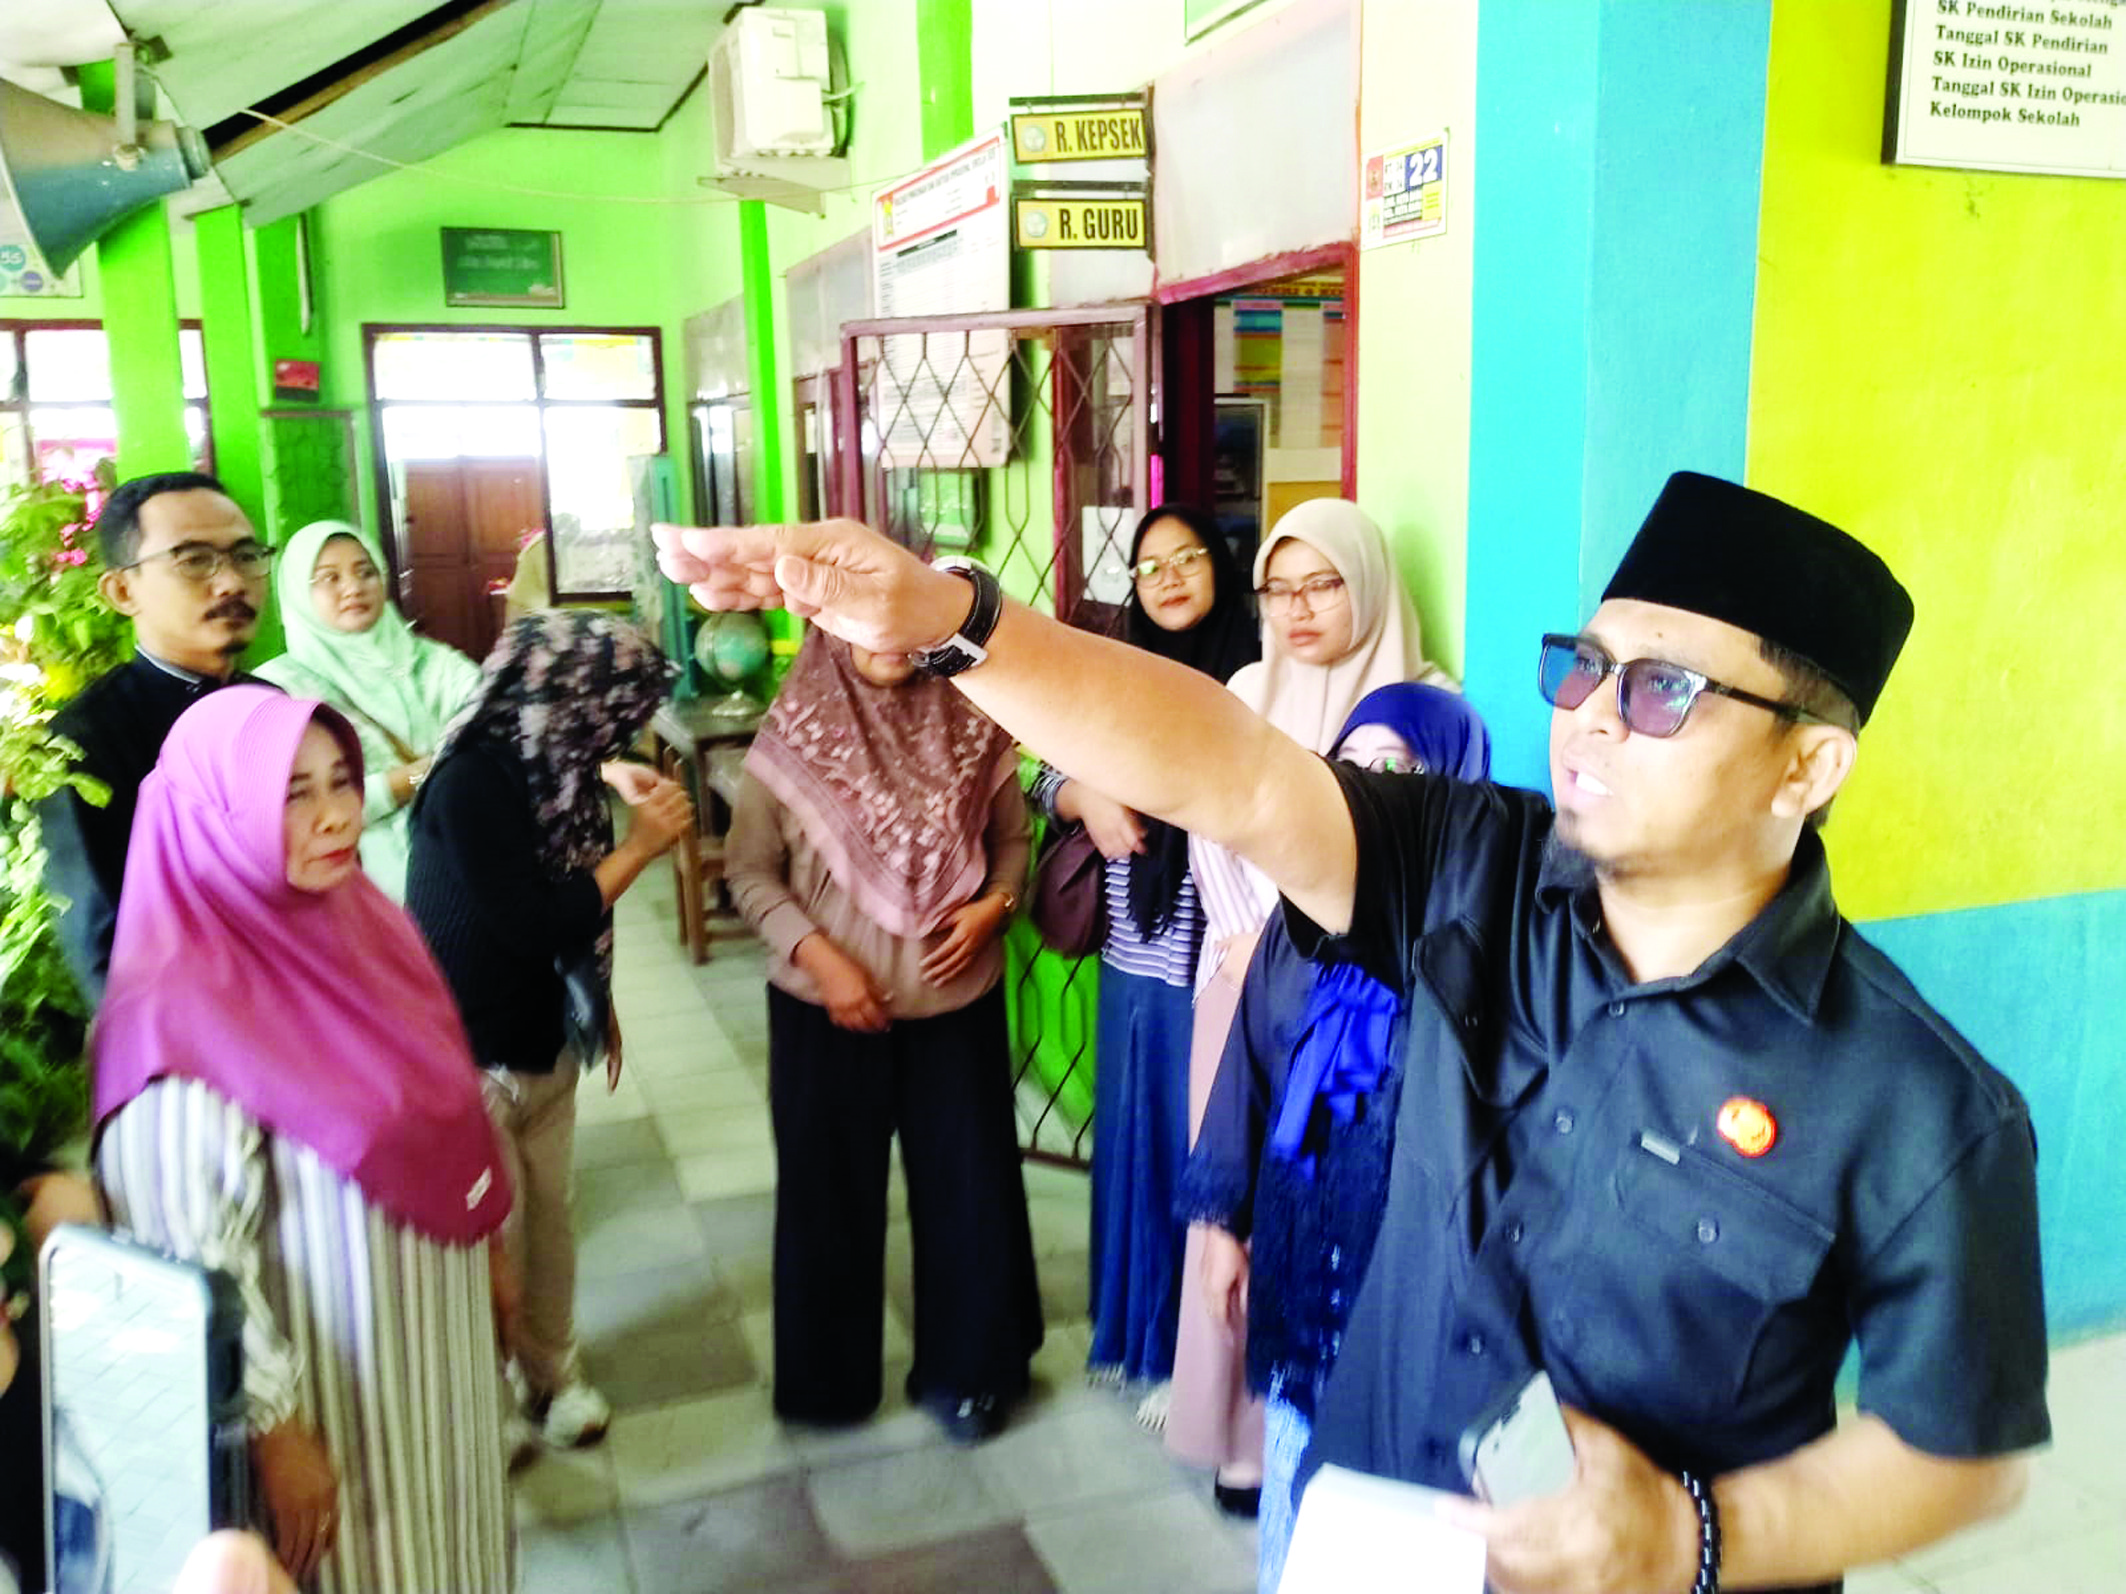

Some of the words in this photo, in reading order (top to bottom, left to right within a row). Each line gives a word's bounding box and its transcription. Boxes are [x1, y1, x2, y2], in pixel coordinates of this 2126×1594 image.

[1937, 0, 1959, 14] SK
[1966, 2, 2044, 24] Pendirian
[2050, 9, 2112, 30] Sekolah
[1935, 25, 1998, 47] Tanggal
[2004, 31, 2025, 47] SK
[2032, 33, 2108, 54] Pendirian
[1933, 51, 1956, 67] SK
[1962, 53, 1992, 70] Izin
[1998, 56, 2091, 78] Operasional
[1932, 76, 1994, 98] Tanggal
[1999, 82, 2021, 97] SK
[2027, 83, 2056, 100] Izin
[1930, 101, 2011, 124] Kelompok
[2018, 108, 2080, 127] Sekolah
[1055, 120, 1073, 152] R.
[1076, 117, 1143, 151] KEPSEK
[1409, 147, 1439, 188] 22
[1059, 208, 1078, 240] R.
[1083, 208, 1138, 240] GURU
